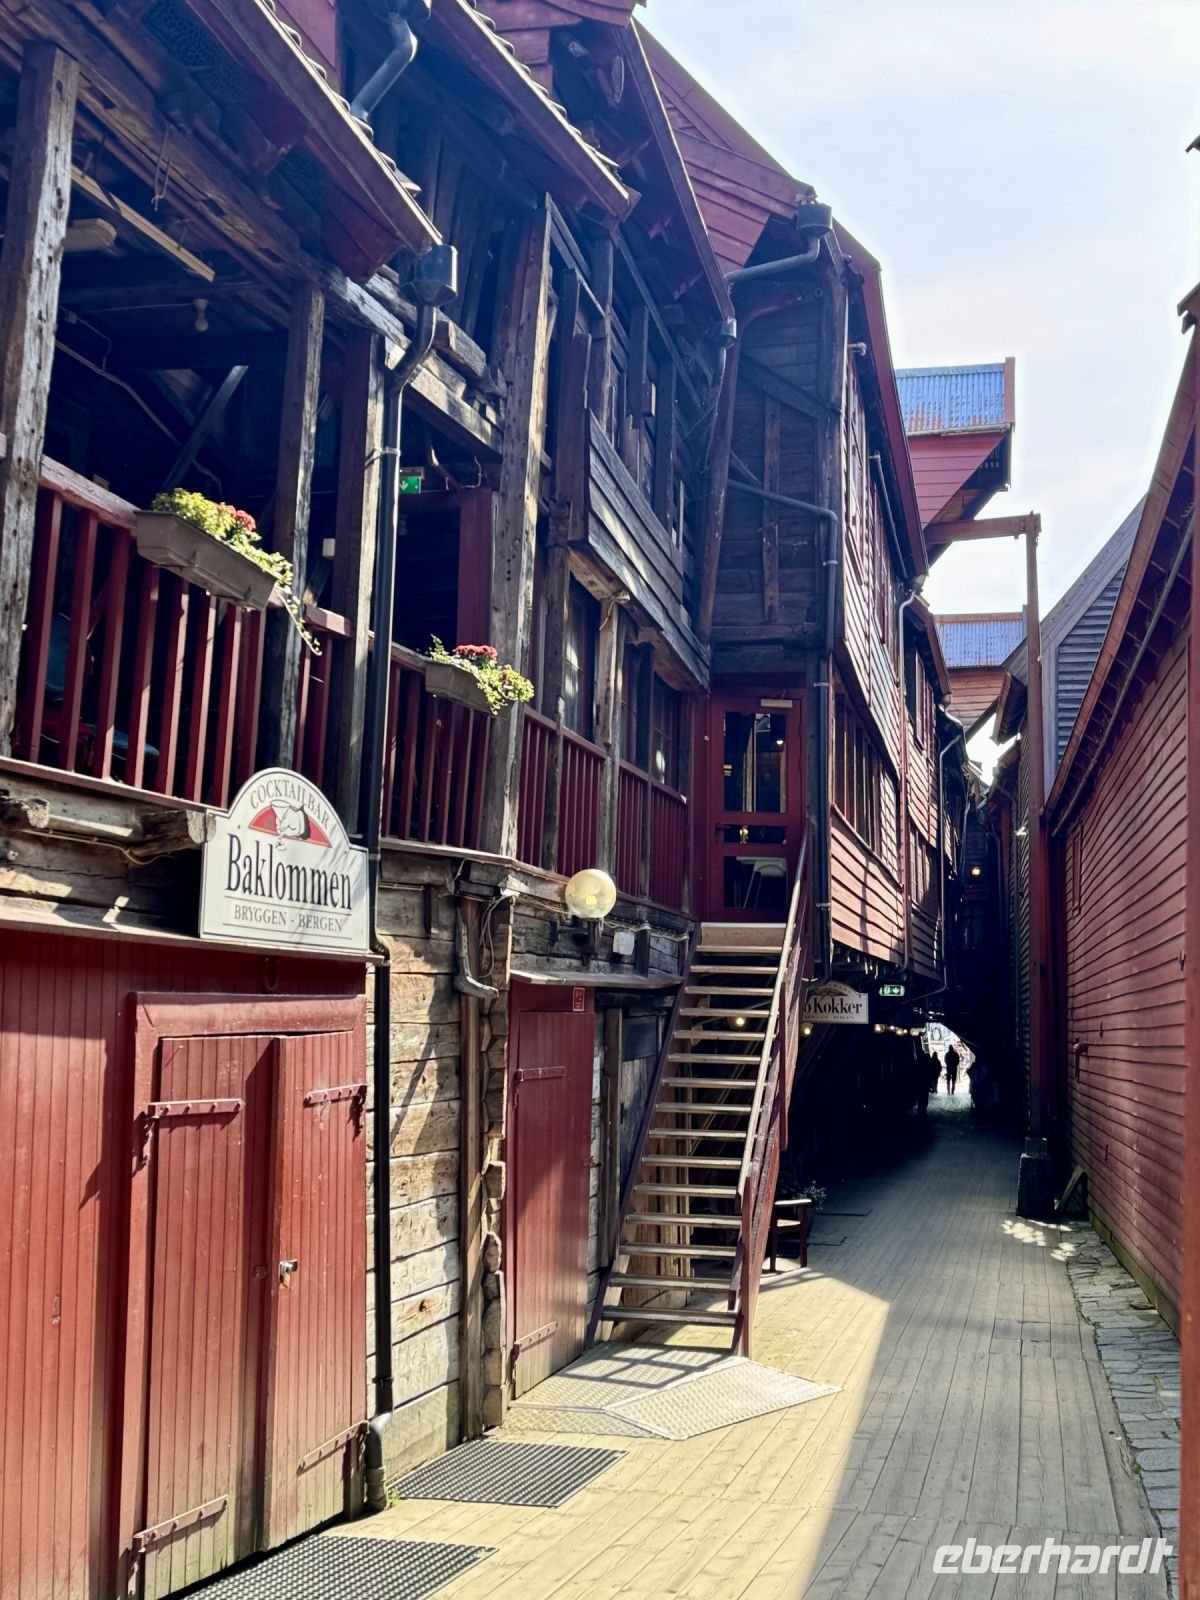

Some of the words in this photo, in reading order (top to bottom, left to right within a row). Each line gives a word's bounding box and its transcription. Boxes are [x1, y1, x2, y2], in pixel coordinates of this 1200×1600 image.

[250, 779, 330, 828] COCKTAILBAR
[225, 833, 352, 910] Baklommen
[234, 904, 287, 926] BRYGGEN
[298, 913, 343, 933] BERGEN
[814, 998, 862, 1014] Kokker
